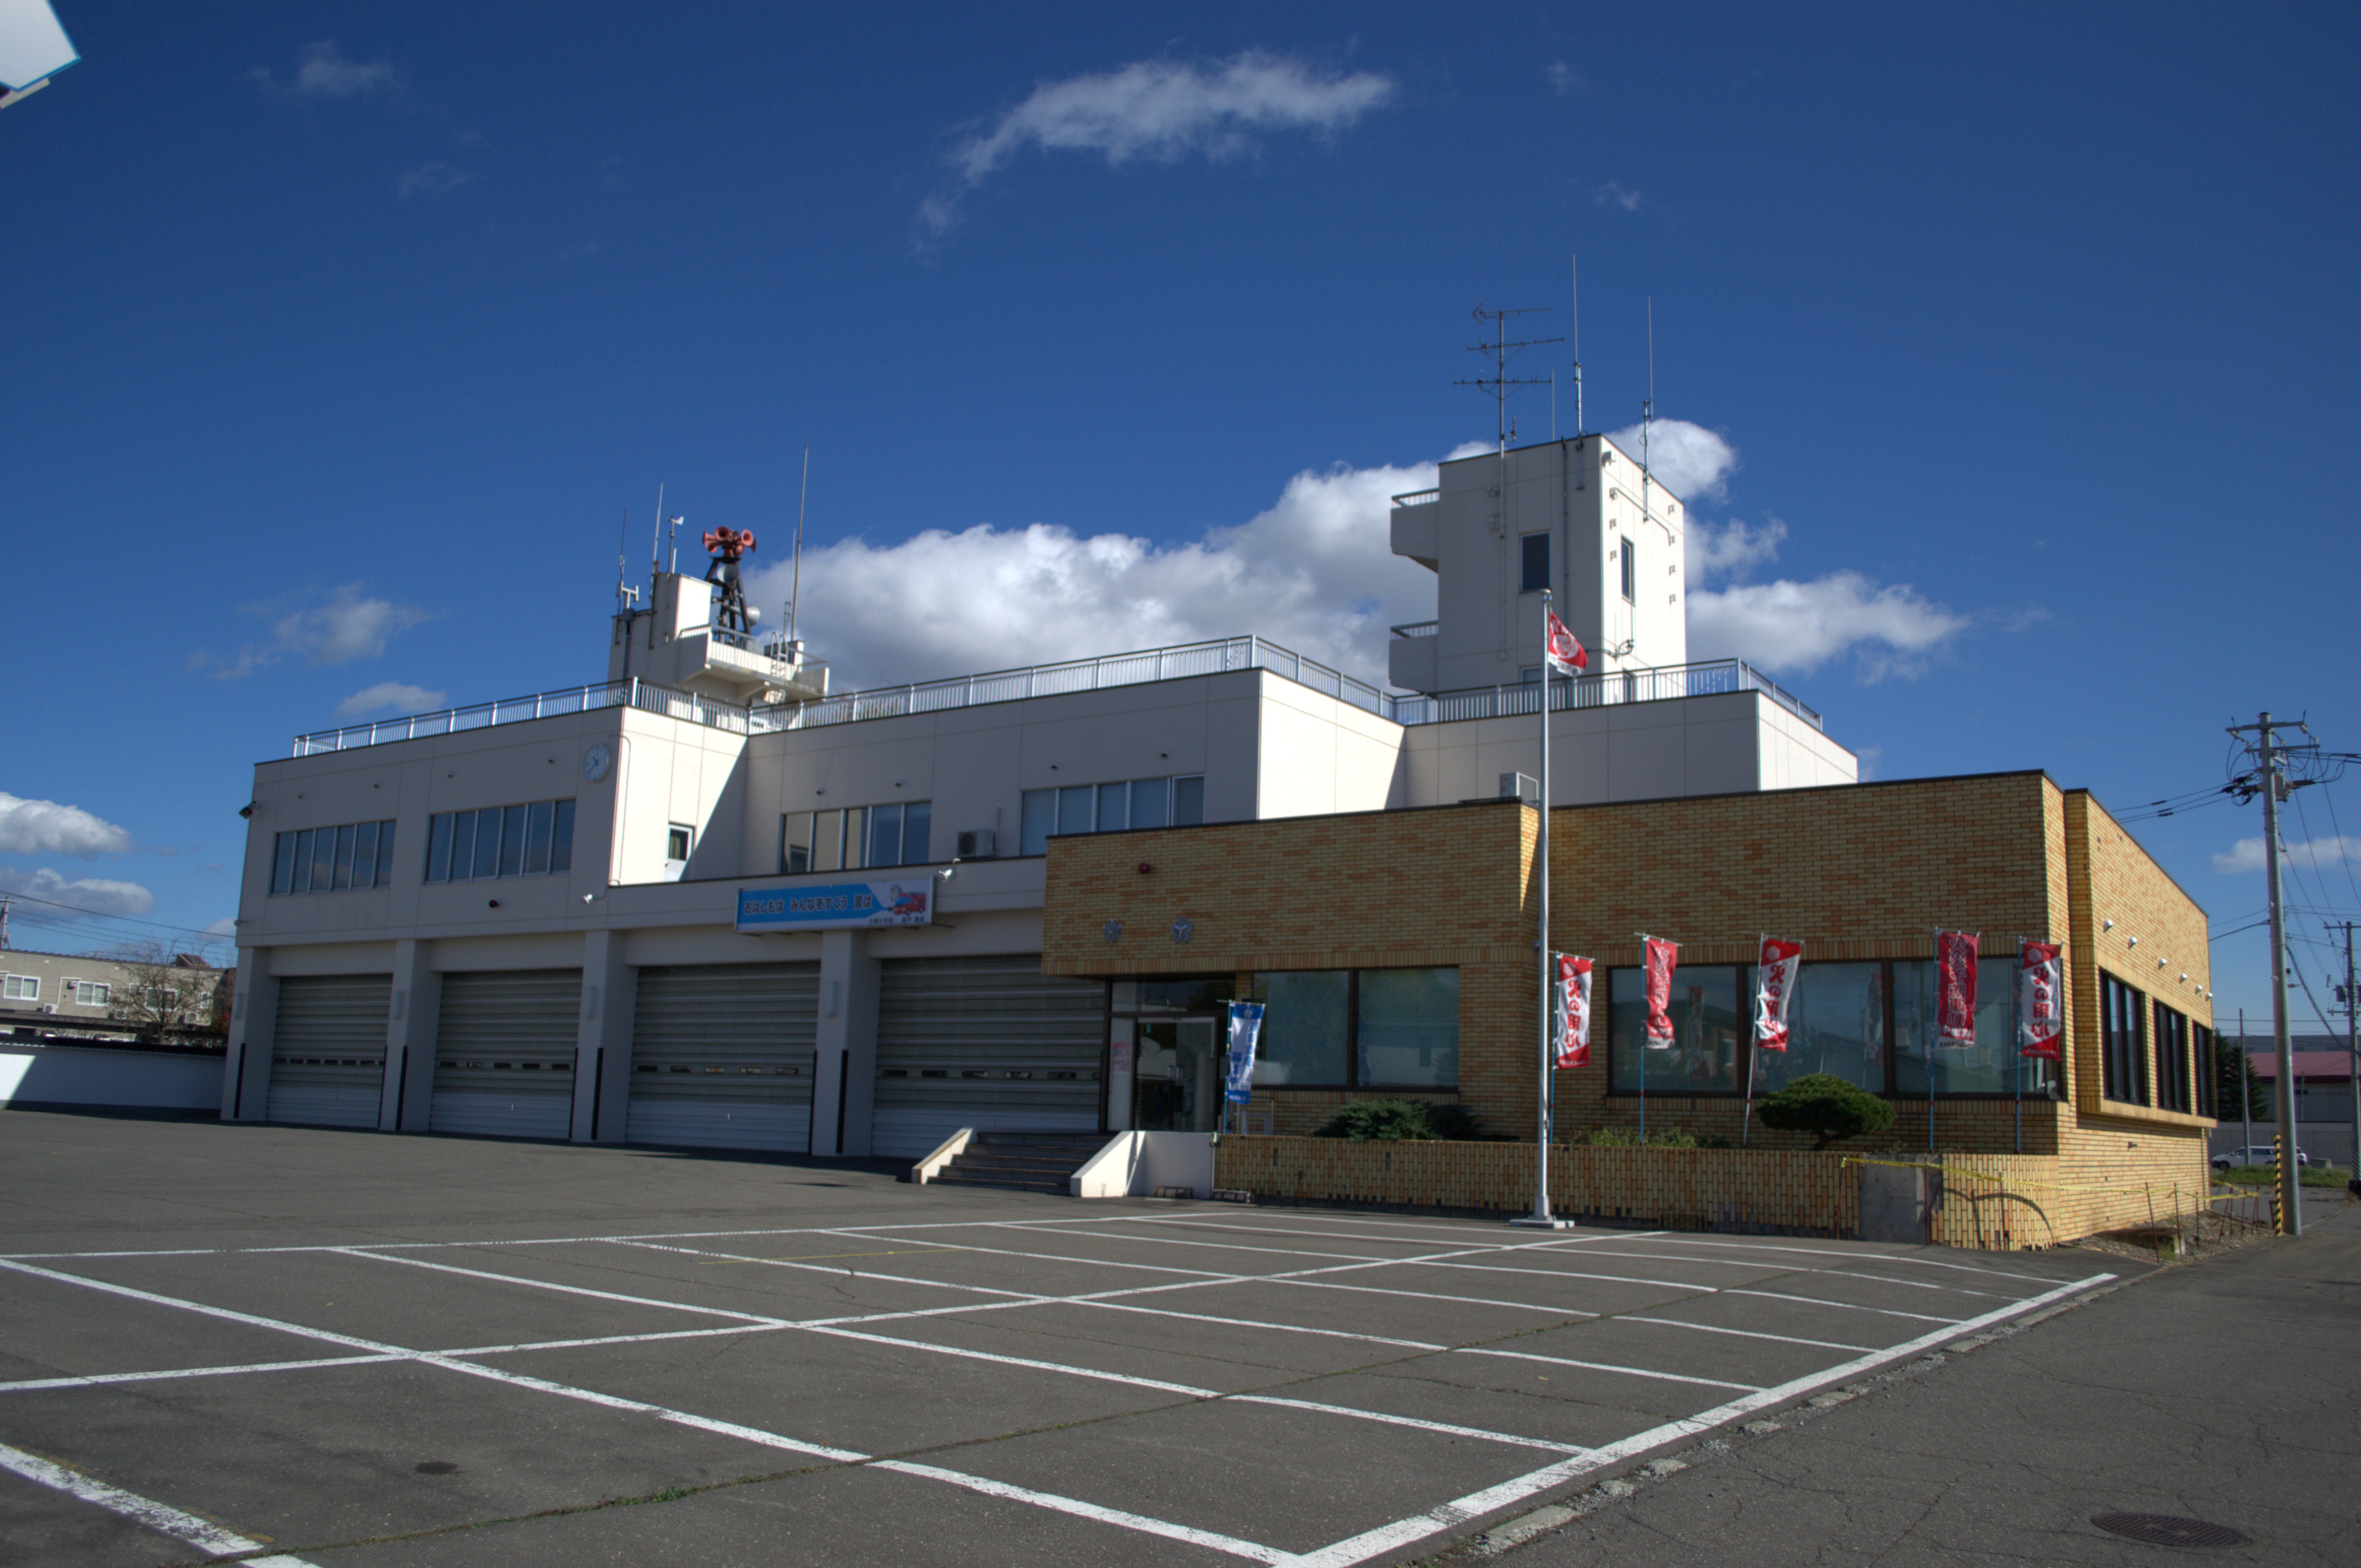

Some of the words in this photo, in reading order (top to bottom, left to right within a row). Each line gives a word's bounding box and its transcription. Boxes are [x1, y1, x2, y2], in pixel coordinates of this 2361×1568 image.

[744, 899, 784, 914] おはしもは
[790, 894, 847, 912] みんなをすくう
[853, 893, 872, 910] 言ば
[1565, 979, 1582, 1048] 火の用心
[2031, 967, 2050, 1038] 火の用心
